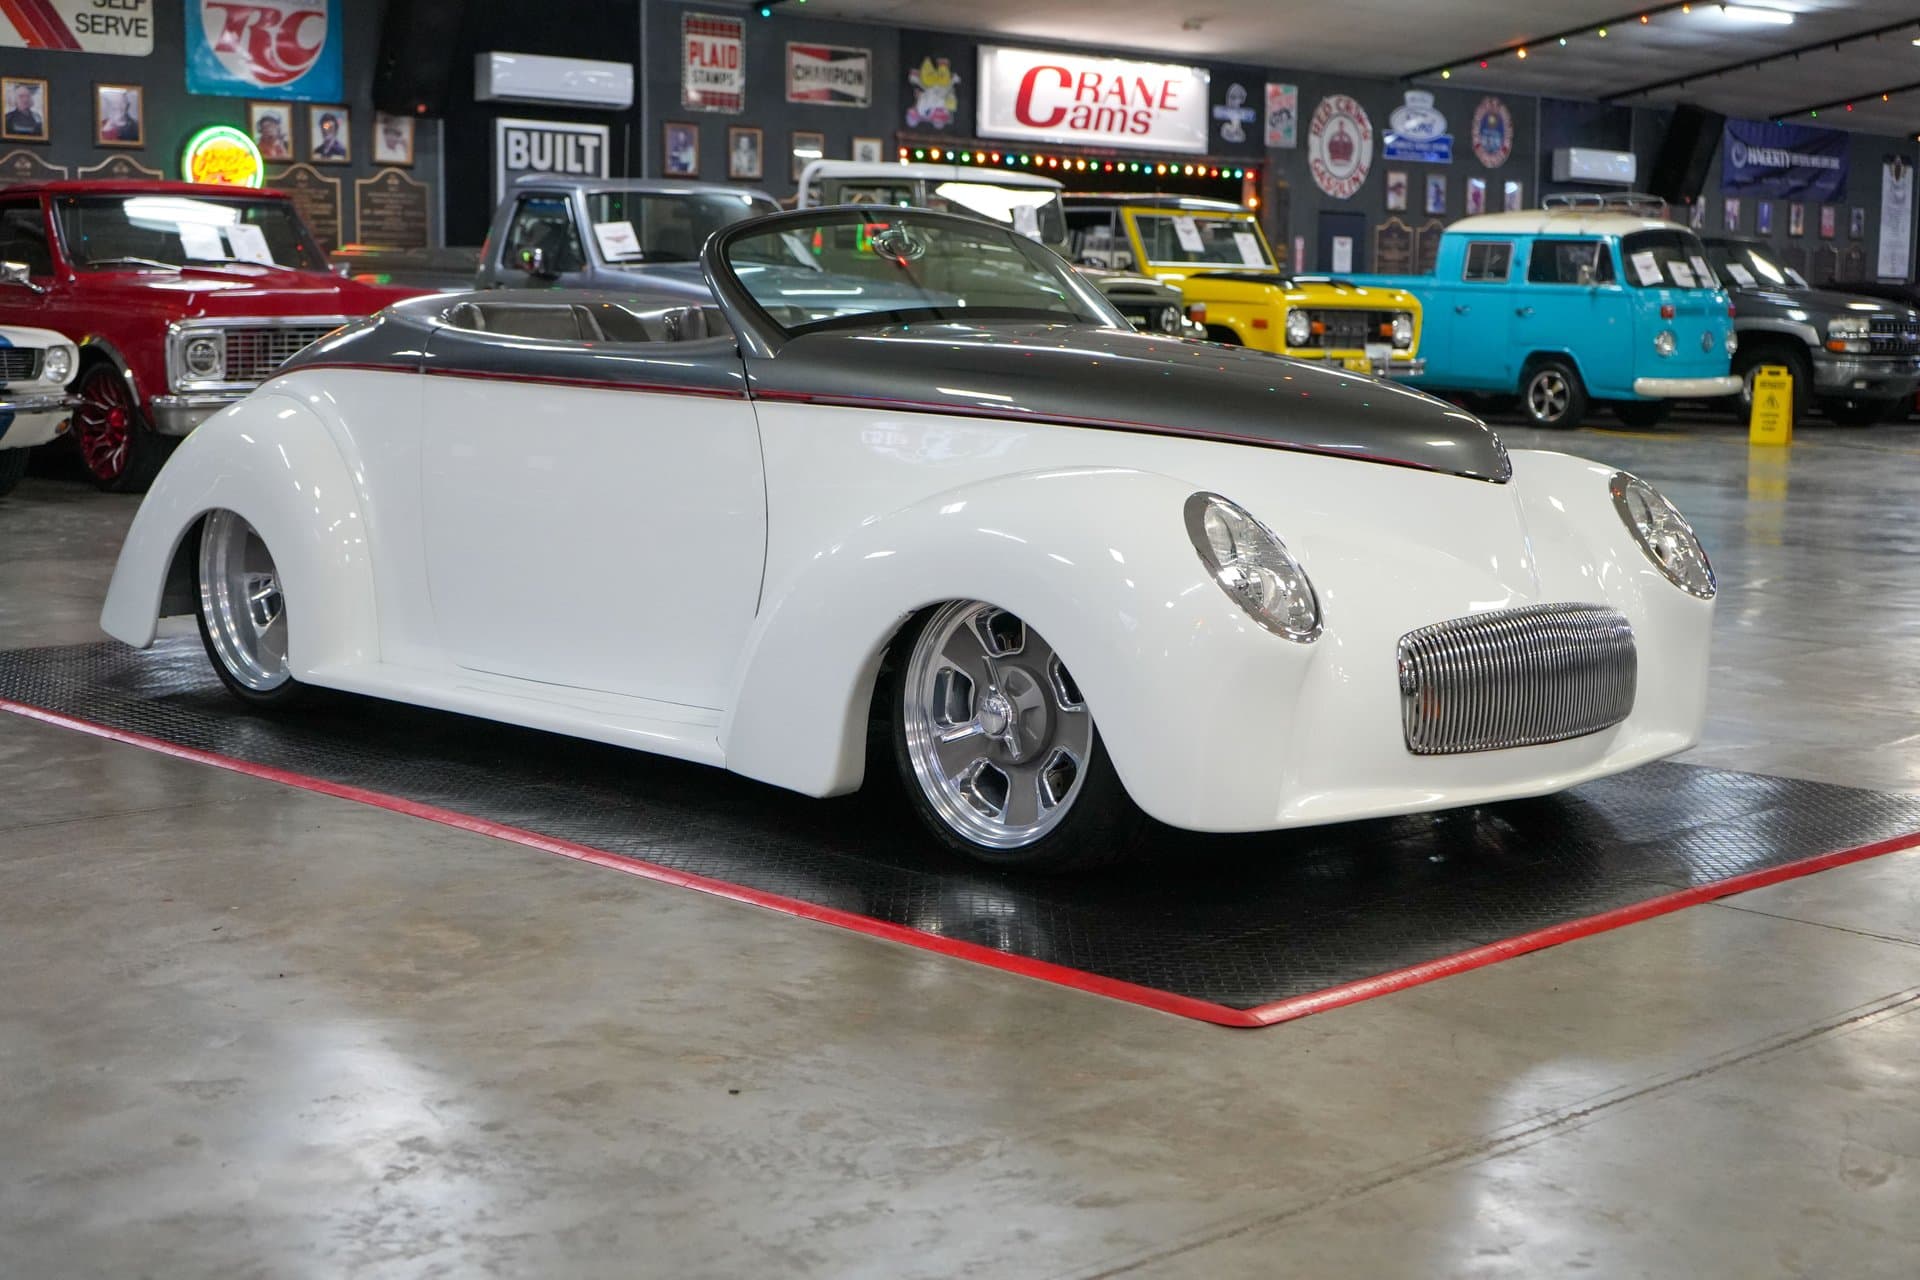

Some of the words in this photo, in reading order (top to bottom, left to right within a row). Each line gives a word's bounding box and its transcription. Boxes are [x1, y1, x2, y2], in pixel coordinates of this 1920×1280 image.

[75, 13, 148, 38] SERVE
[206, 2, 324, 84] RC
[689, 41, 738, 69] PLAID
[692, 69, 735, 86] STAMPS
[793, 63, 863, 86] CHAMPION
[1015, 65, 1182, 128] CRANE
[508, 131, 599, 174] BUILT
